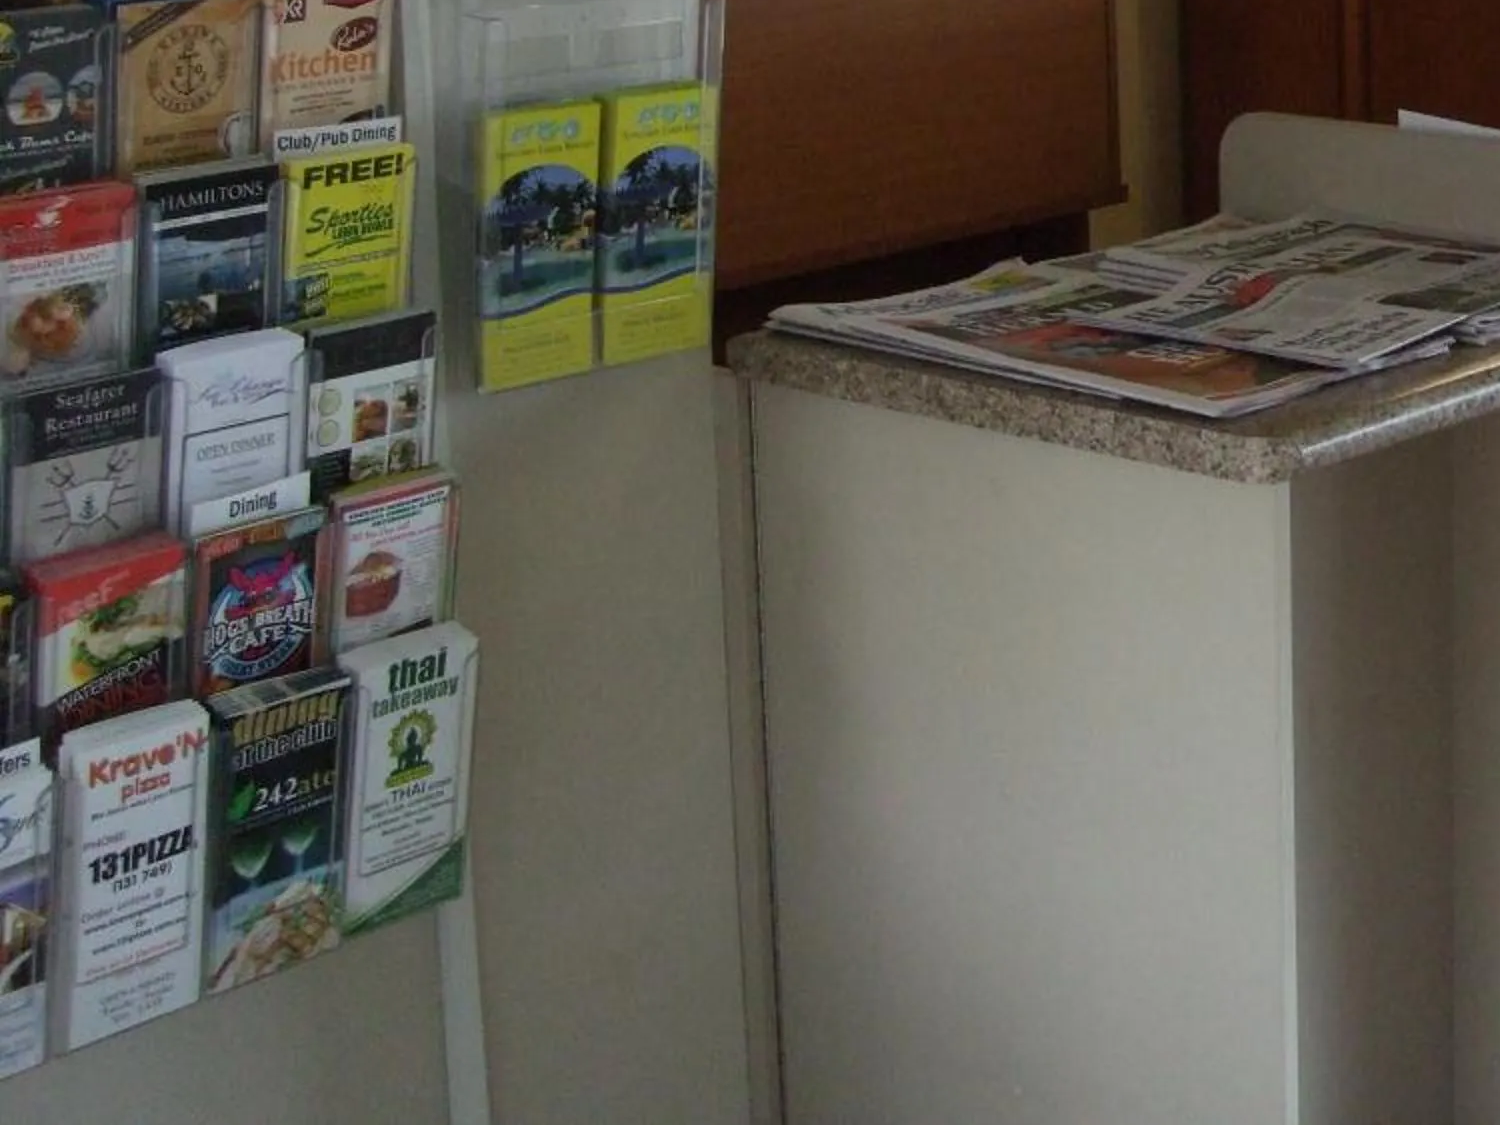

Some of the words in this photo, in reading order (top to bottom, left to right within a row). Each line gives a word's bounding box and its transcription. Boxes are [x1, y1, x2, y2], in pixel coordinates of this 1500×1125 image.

[272, 48, 376, 82] Kitchen
[277, 129, 349, 152] Club/Pub
[352, 124, 397, 142] Dining
[303, 152, 404, 190] FREE!
[160, 180, 265, 212] HAMILTONS
[56, 385, 126, 409] Seafarer
[45, 402, 139, 433] Restaurant
[229, 491, 277, 518] Dining
[255, 599, 313, 627] BREATH
[230, 624, 287, 654] CAFE
[388, 646, 448, 693] thai
[372, 675, 460, 720] takeaway
[392, 781, 426, 803] THAI
